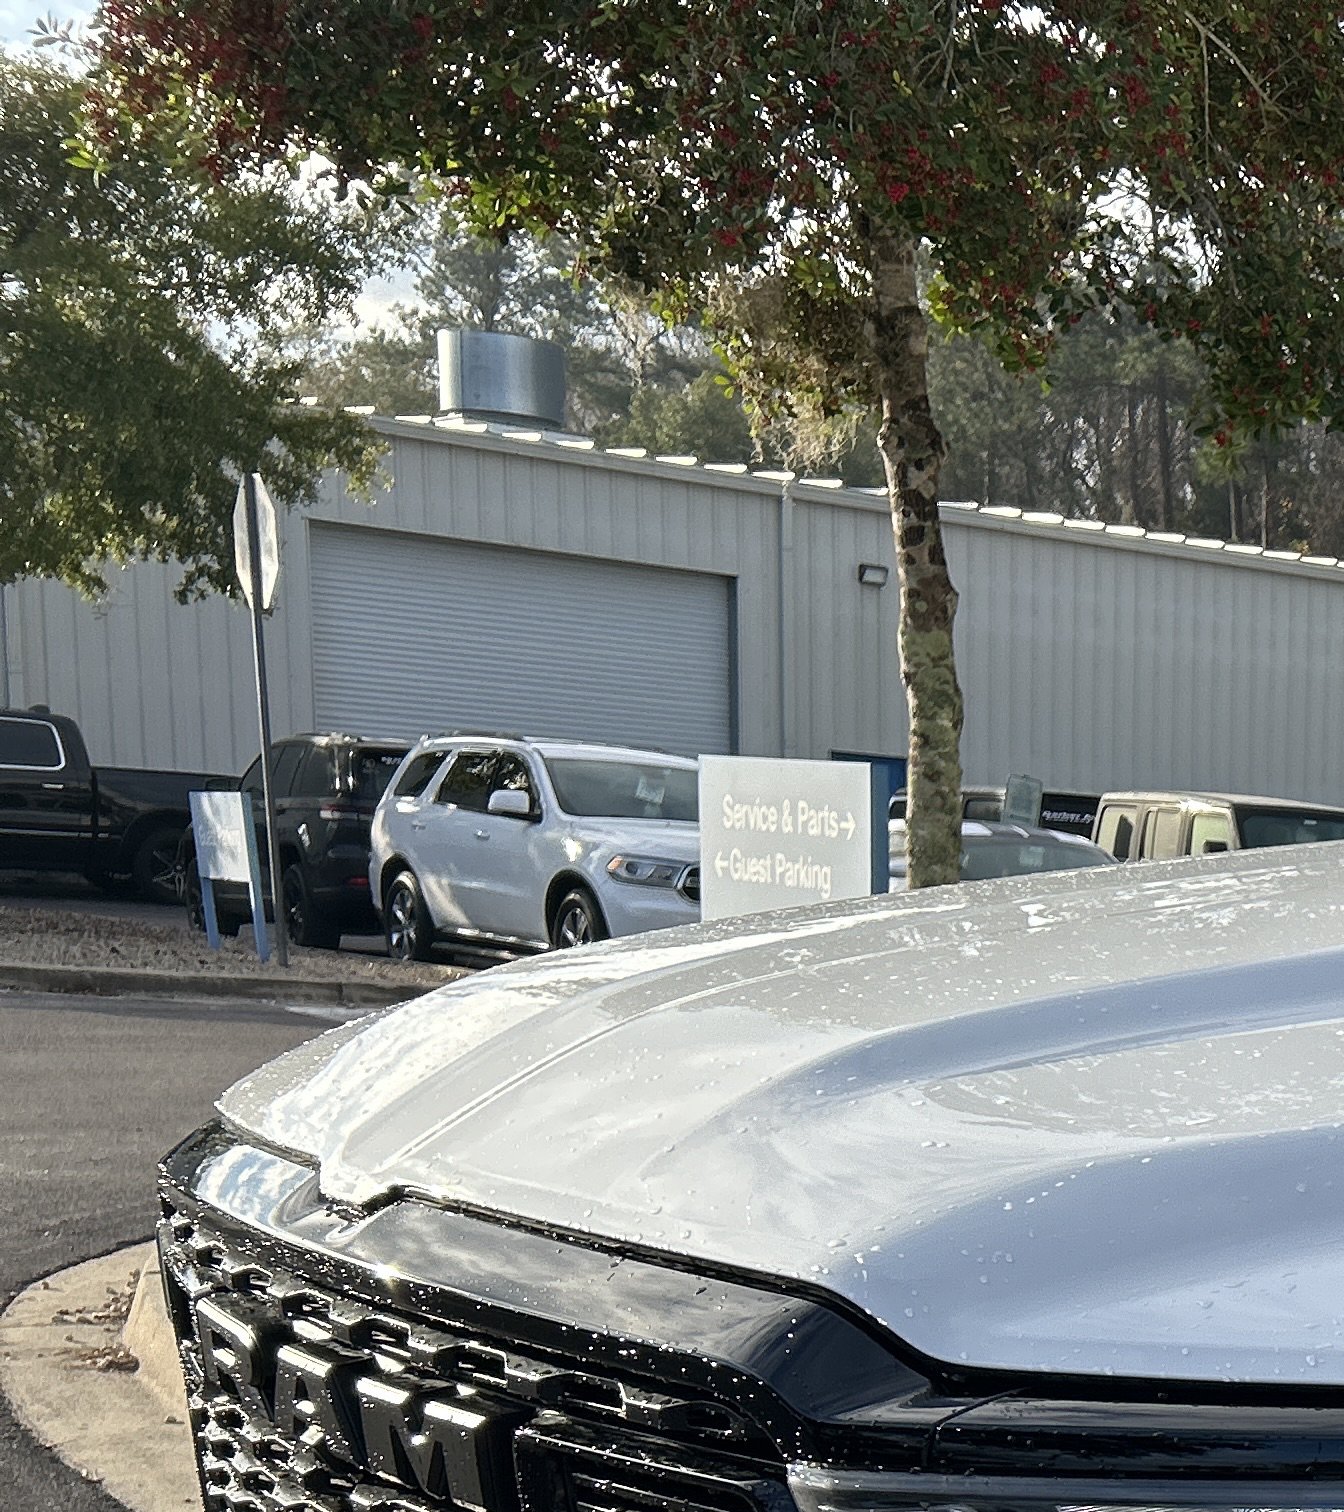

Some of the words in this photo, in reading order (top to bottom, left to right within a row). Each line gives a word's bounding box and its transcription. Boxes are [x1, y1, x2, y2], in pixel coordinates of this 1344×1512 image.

[722, 793, 778, 833] Service
[781, 799, 794, 834] &
[797, 800, 839, 838] Parts
[730, 848, 772, 883] Guest
[775, 853, 832, 899] Parking
